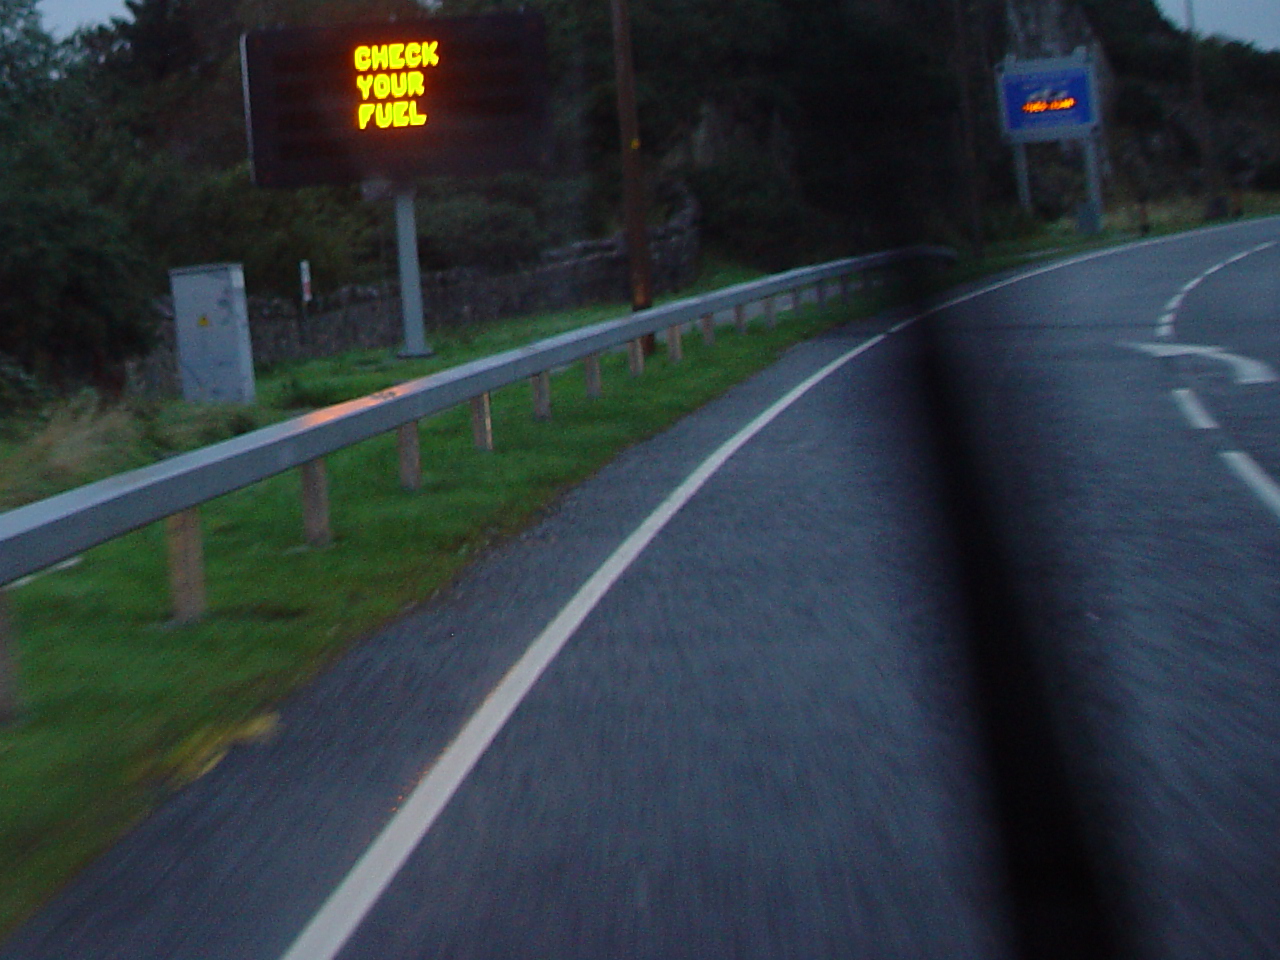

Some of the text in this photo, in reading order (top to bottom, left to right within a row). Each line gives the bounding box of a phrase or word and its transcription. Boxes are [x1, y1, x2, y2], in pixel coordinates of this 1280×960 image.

[354, 41, 440, 71] CHECK
[356, 71, 425, 100] YOUR
[358, 100, 427, 129] FUEL
